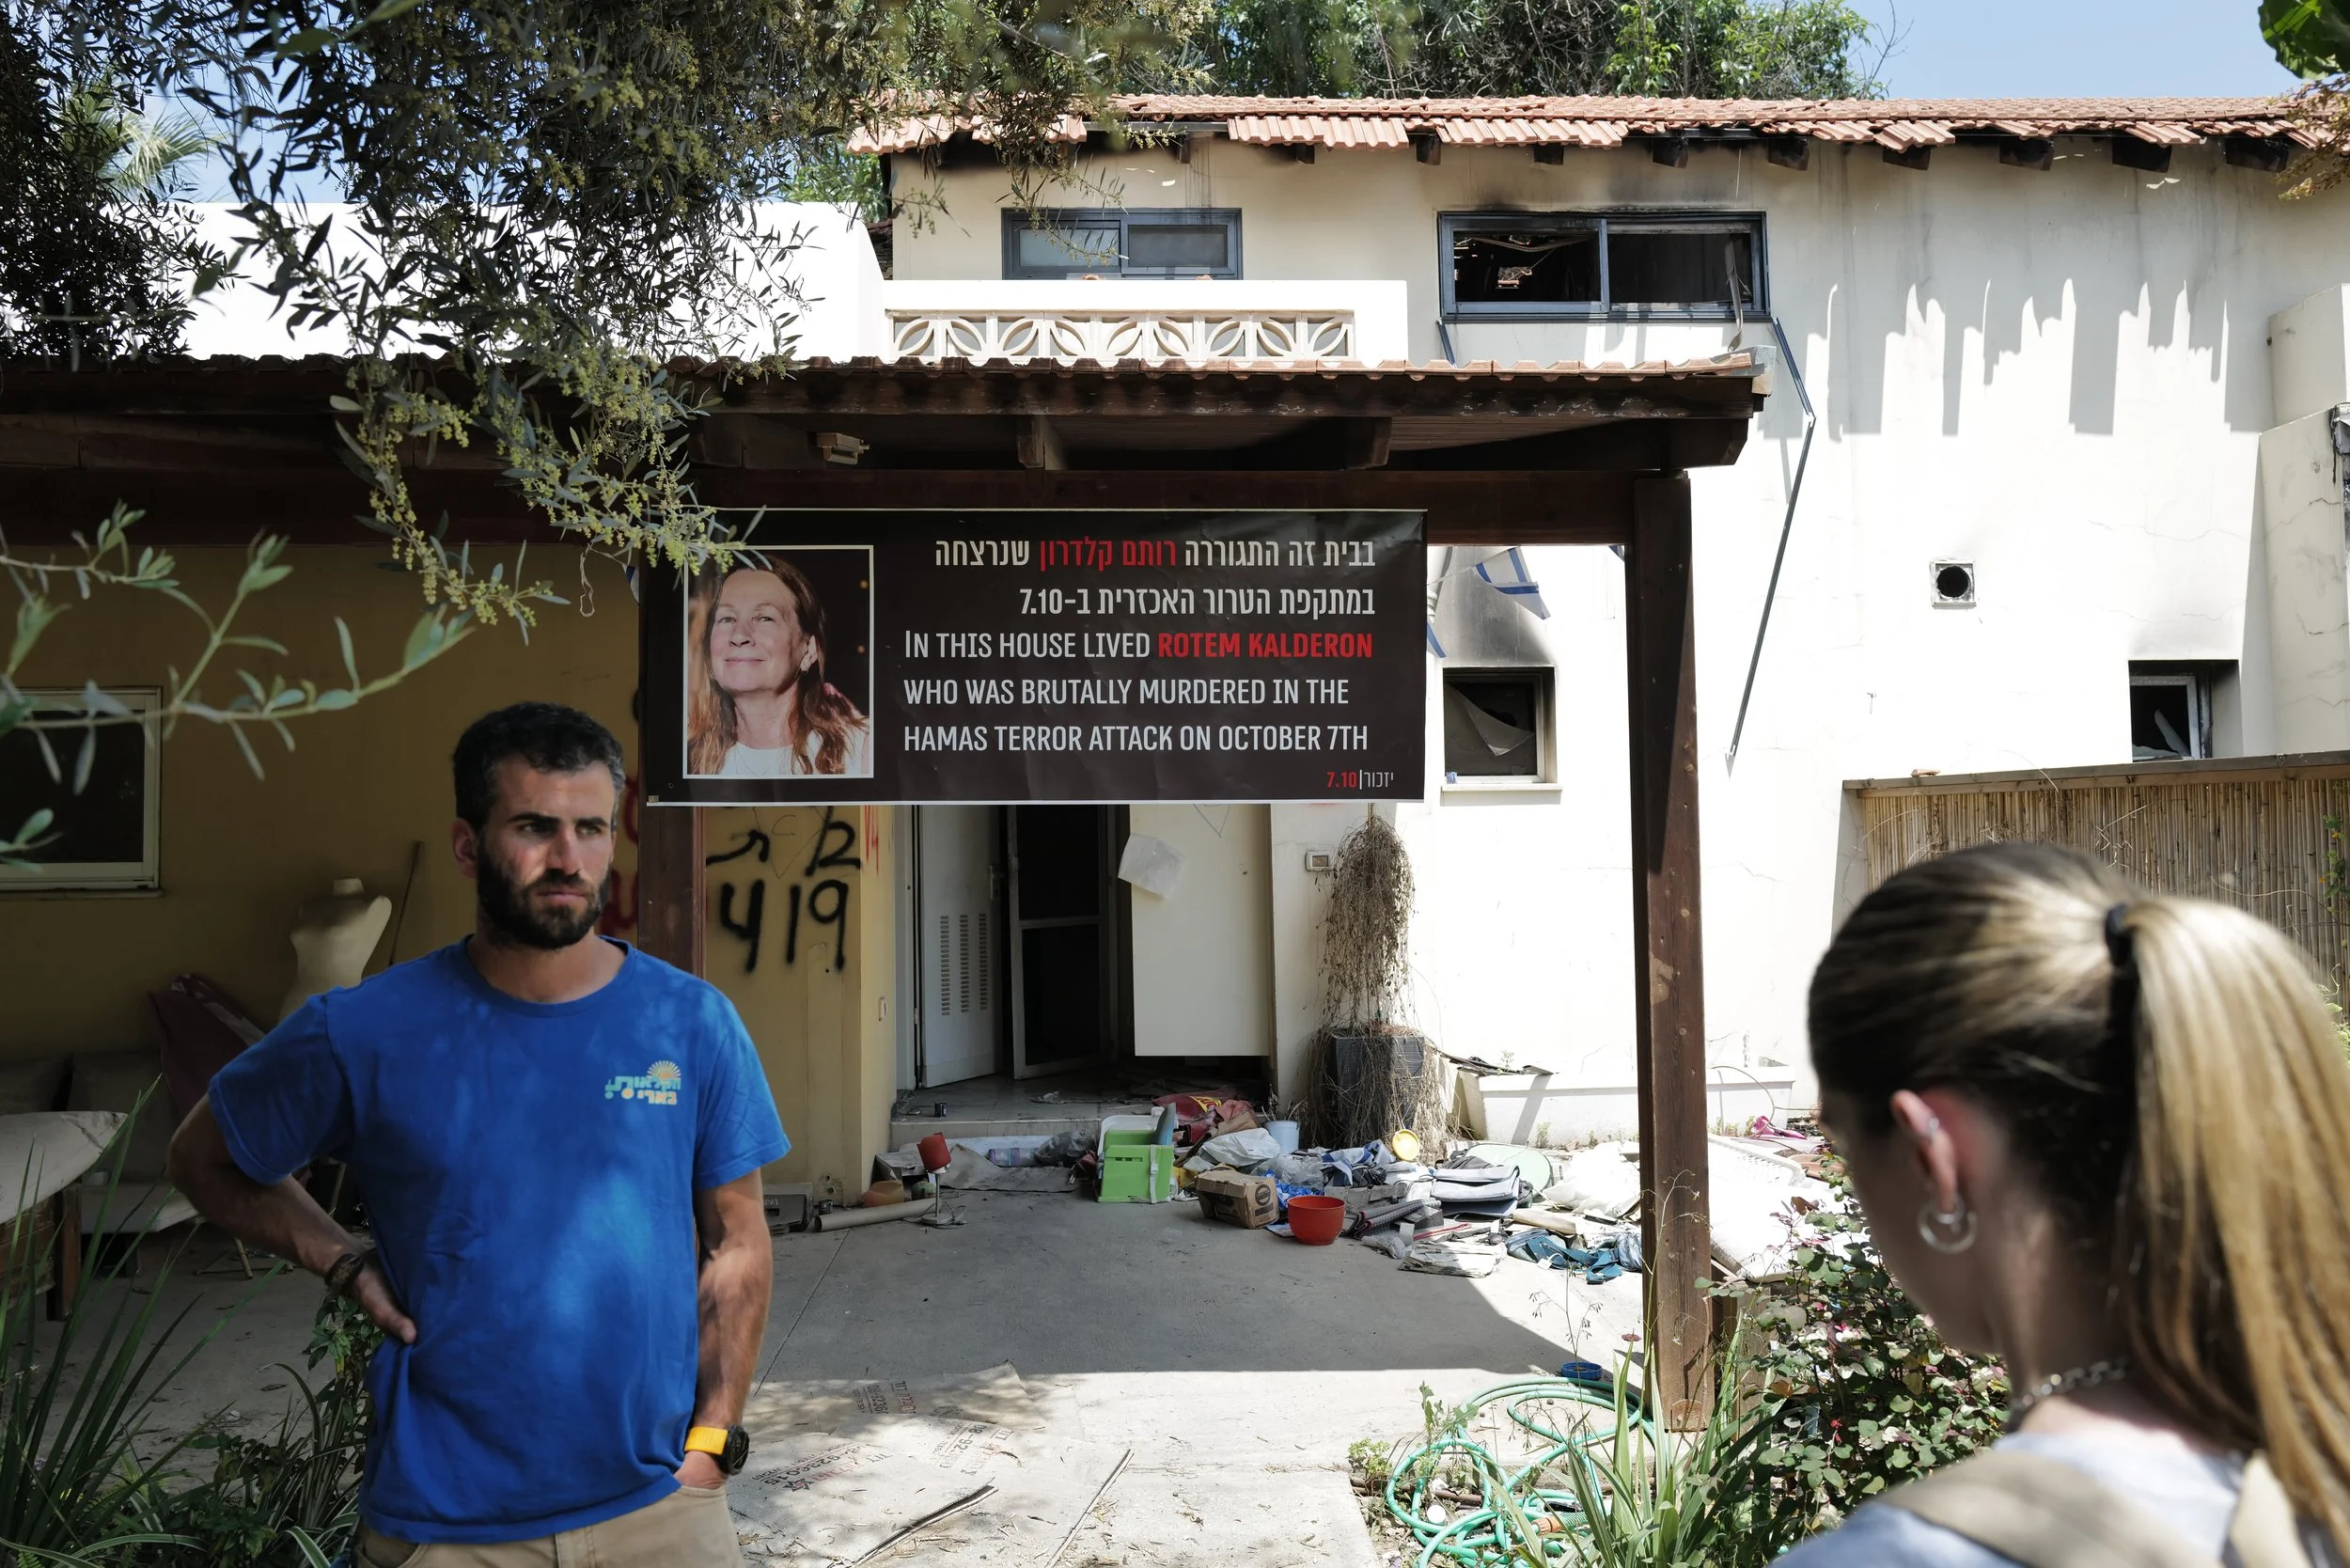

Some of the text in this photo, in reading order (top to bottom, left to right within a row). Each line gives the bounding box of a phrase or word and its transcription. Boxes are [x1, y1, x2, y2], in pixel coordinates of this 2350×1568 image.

[935, 535, 1375, 572] בבית זה התגוררה רותם קלדרון שנרצחה
[1098, 588, 1195, 614] האכזרית
[1203, 588, 1270, 614] הטרור
[1279, 588, 1375, 619] במתקפת
[905, 630, 1372, 659] IN THIS HOUSE LIVED ROTEM KALDERON
[903, 679, 1349, 705] WHO WAS BRUTALLY MURDERED IN THE
[904, 725, 1368, 751] HAMAS TERROR ATTACK ON OCTOBER 7TH
[637, 1090, 677, 1105] בארי
